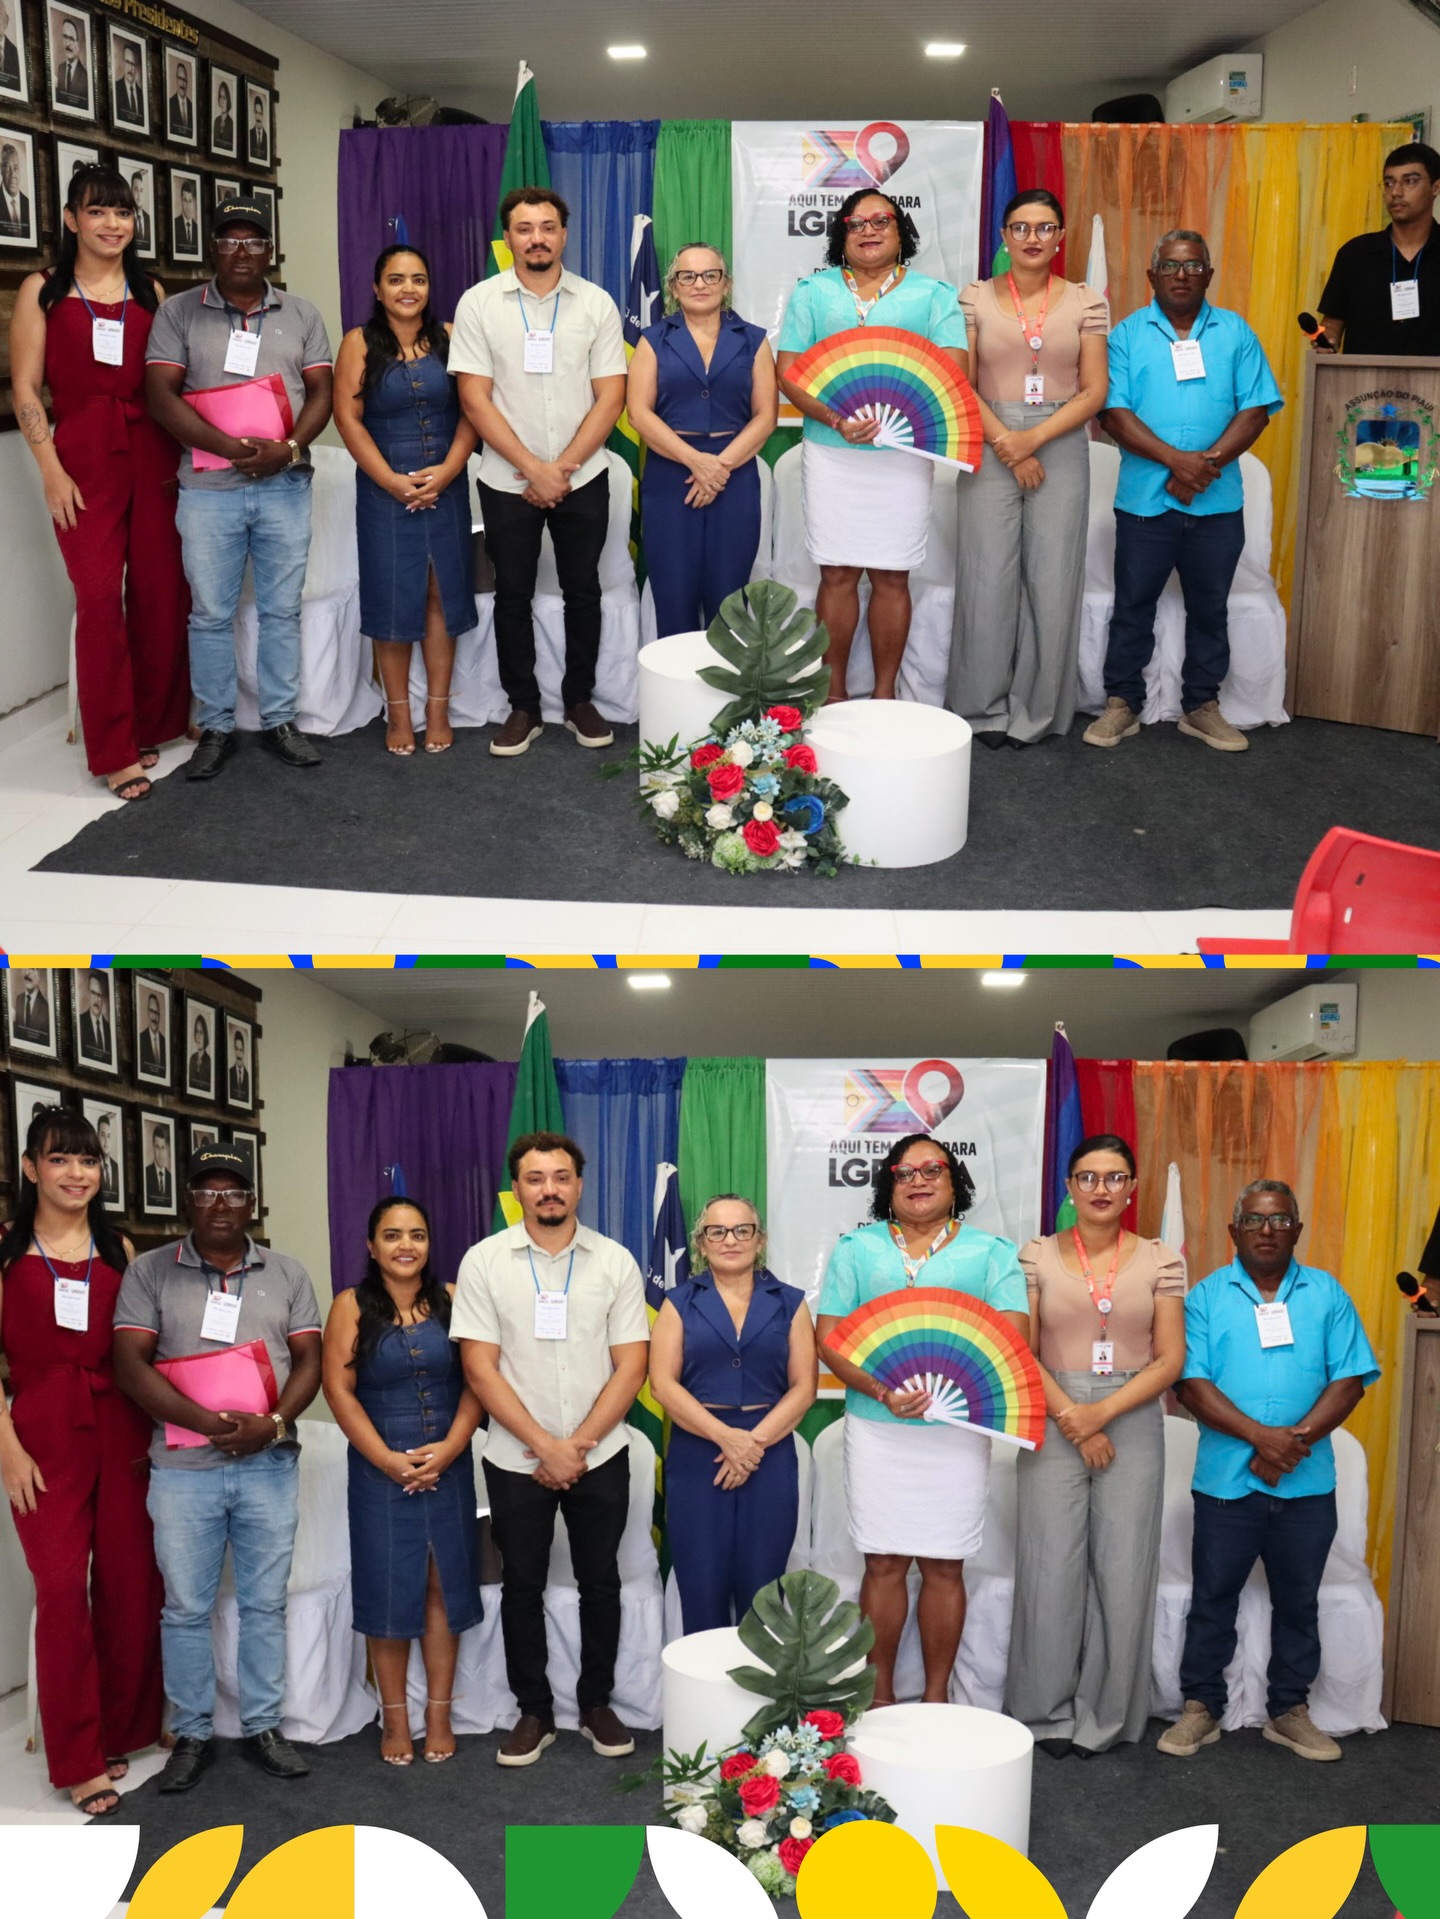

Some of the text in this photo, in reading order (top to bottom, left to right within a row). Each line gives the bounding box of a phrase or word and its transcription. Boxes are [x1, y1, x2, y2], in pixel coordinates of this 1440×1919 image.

[788, 194, 817, 207] AQUI
[630, 314, 641, 328] de
[1395, 389, 1410, 400] DO
[829, 1140, 861, 1155] AQUI
[652, 1274, 665, 1289] de
